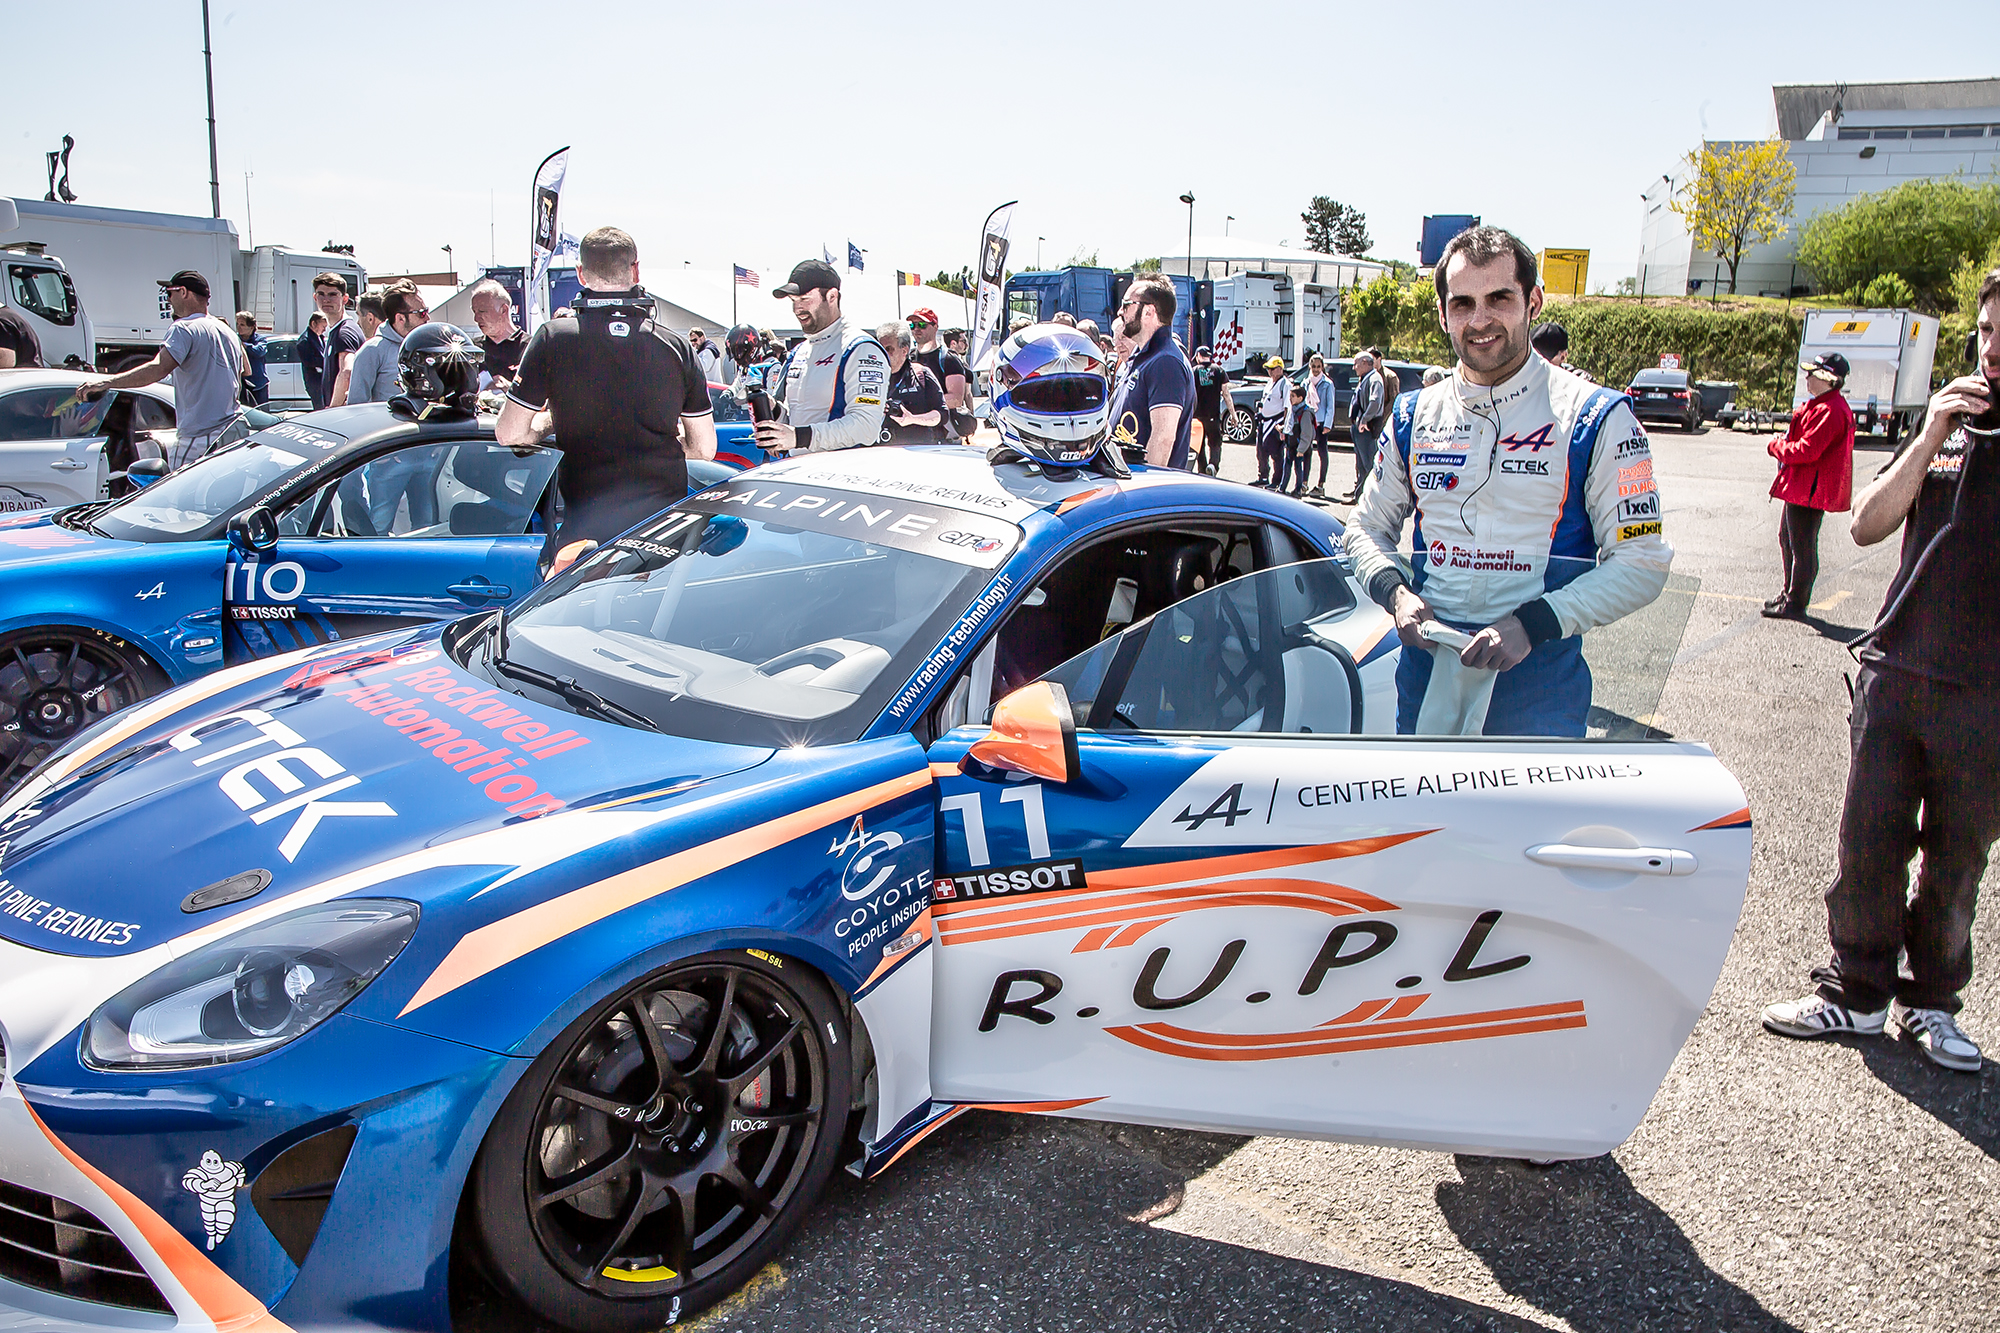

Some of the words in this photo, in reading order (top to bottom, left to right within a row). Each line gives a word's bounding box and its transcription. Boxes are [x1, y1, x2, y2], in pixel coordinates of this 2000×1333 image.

[1582, 394, 1610, 427] Sabelt
[1426, 456, 1463, 465] MICHELIN
[1501, 459, 1549, 474] CTEK
[865, 478, 933, 495] ALPINE
[931, 486, 1014, 509] RENNES
[1416, 472, 1445, 490] elf
[639, 511, 704, 541] 11
[722, 488, 939, 538] ALPINE
[1450, 557, 1532, 572] Automation
[1452, 546, 1515, 561] Rockwell
[225, 561, 306, 602] 110
[248, 606, 297, 619] TISSOT
[888, 573, 1014, 719] www.racing-technology.fr
[393, 665, 593, 760] Rockwell
[332, 682, 567, 820] Automation
[168, 708, 399, 864] CTEK
[1298, 777, 1408, 808] CENTRE
[1415, 767, 1519, 796] ALPINE
[1528, 762, 1643, 785] RENNES
[940, 783, 1051, 867] 11
[955, 863, 1076, 897] TISSOT
[834, 869, 933, 938] COYOTE
[36, 906, 142, 945] RENNES
[848, 919, 889, 958] PEOPLE
[891, 895, 929, 929] INSIDE
